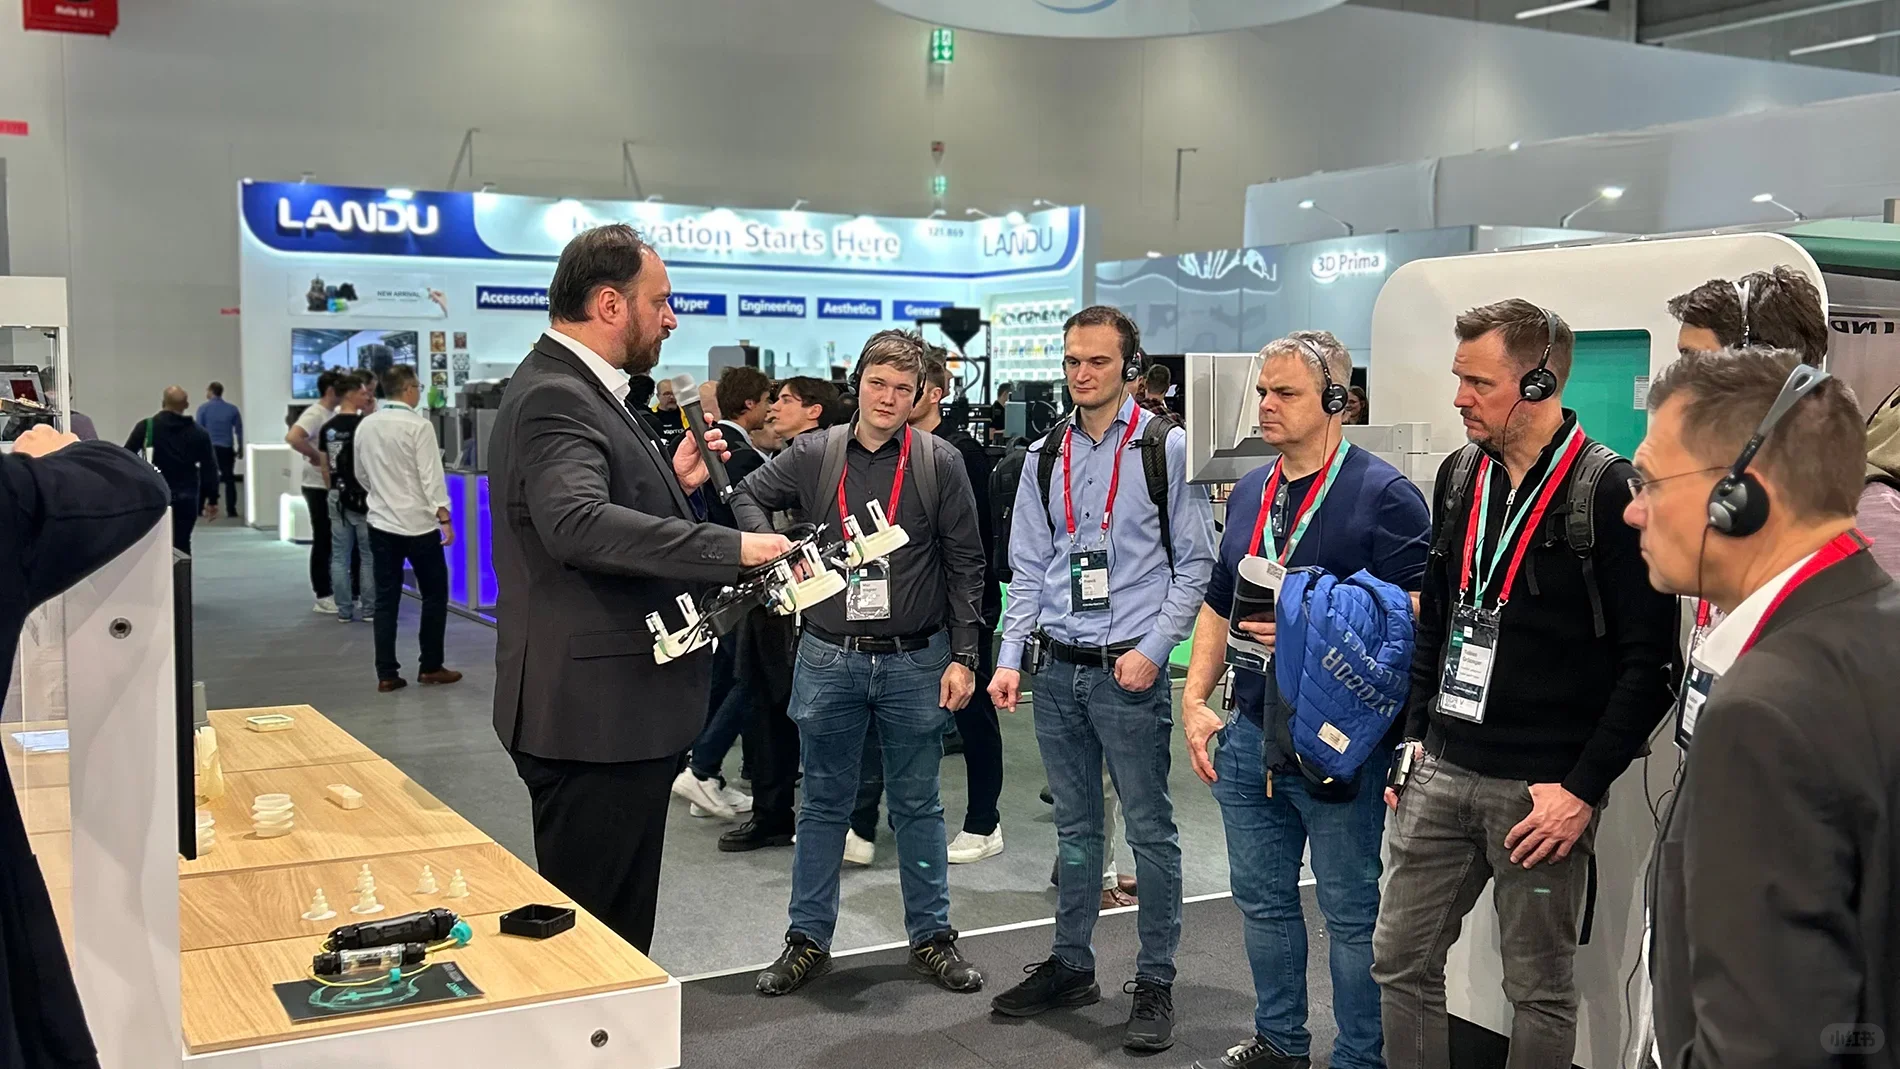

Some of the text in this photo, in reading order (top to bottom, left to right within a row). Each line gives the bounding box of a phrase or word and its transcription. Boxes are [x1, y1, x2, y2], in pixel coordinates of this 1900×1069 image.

[278, 197, 439, 235] LANDU
[572, 215, 898, 254] Ivation Starts Here
[983, 226, 1053, 257] LANDU
[1318, 252, 1380, 272] 3D Prima
[674, 297, 709, 311] Hyper
[740, 299, 804, 315] Engineering
[823, 301, 877, 316] Aesthetics
[904, 304, 941, 317] Genera
